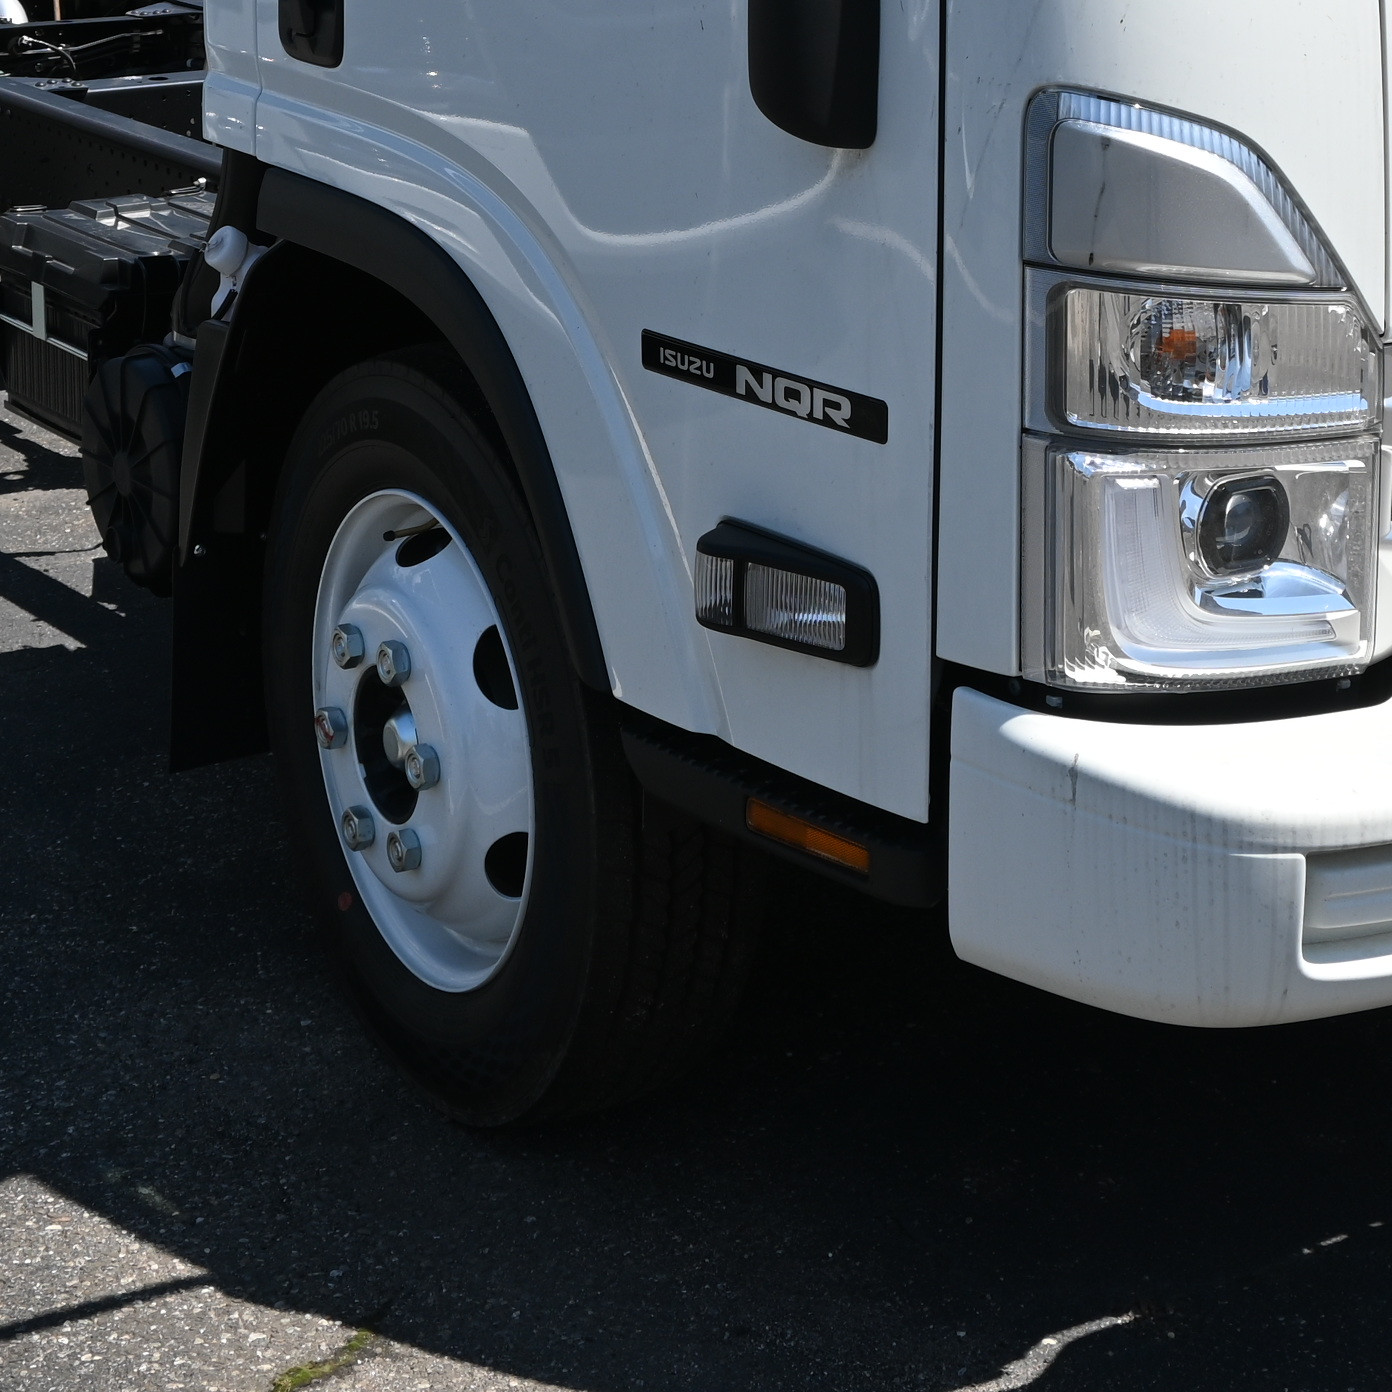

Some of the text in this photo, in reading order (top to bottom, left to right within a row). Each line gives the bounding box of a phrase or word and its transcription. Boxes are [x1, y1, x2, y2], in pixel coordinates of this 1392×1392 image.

[659, 347, 851, 429] ISUZU NQR
[349, 412, 358, 433] R
[358, 409, 379, 431] 19.5
